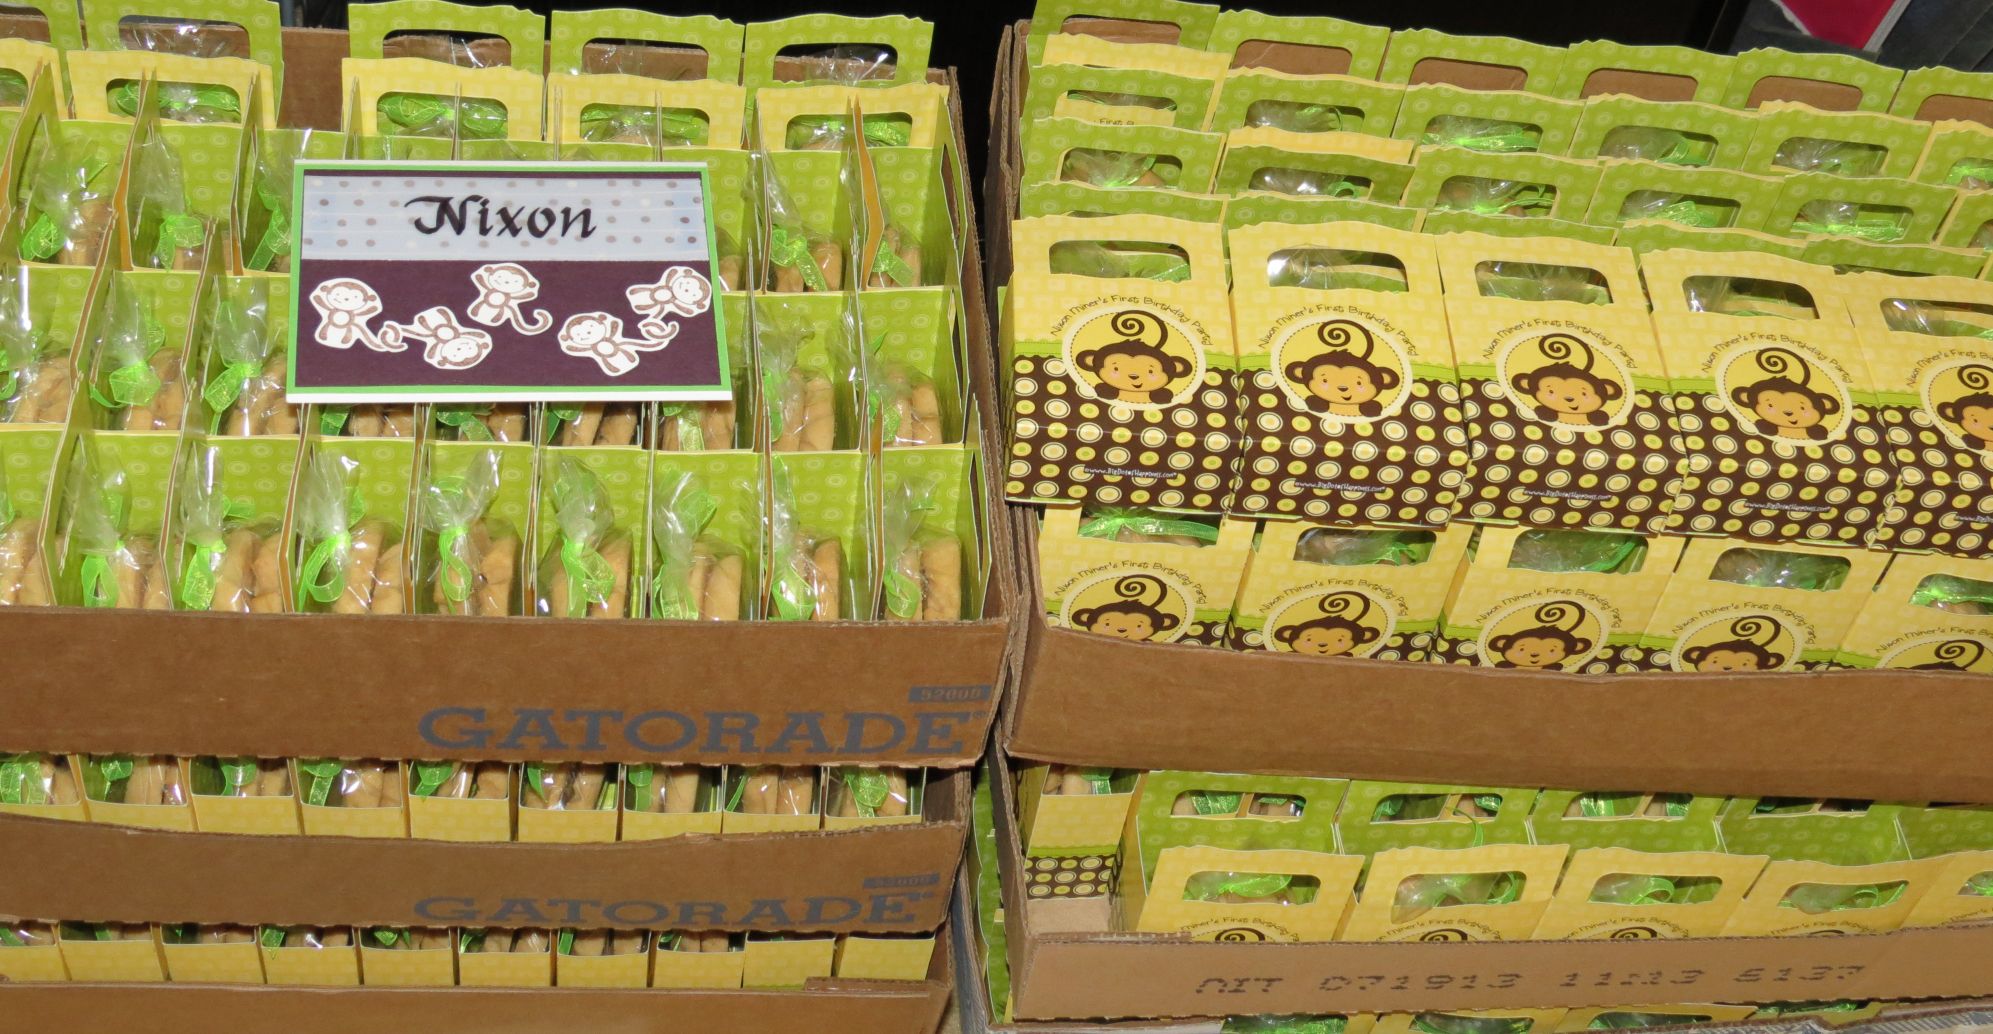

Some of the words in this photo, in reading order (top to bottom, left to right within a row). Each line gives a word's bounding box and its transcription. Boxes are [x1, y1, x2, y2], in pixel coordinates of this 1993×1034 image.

[404, 194, 597, 239] Nixon
[1050, 314, 1072, 336] Nixon
[1110, 294, 1140, 304] First
[1144, 296, 1190, 324] Birthday
[1191, 320, 1214, 346] Party
[1258, 326, 1279, 349] Nixon
[1316, 304, 1344, 313] First
[1348, 305, 1395, 332] Birthday
[1396, 330, 1419, 357] Party
[1483, 338, 1501, 359] Nixon
[1534, 318, 1562, 327] First
[1565, 320, 1613, 346] Birthday
[1614, 344, 1638, 369] Party
[1701, 351, 1718, 373] Nixon
[1750, 332, 1776, 341] First
[1780, 334, 1827, 360] Birthday
[1829, 358, 1854, 384] Party
[1906, 368, 1921, 388] Nixon
[1949, 349, 1976, 358] First
[1054, 577, 1079, 596] Nixon
[1122, 560, 1148, 569] First
[1152, 562, 1193, 586] Birthday
[1192, 584, 1208, 605] Party
[1259, 594, 1285, 614] Nixon
[1328, 578, 1354, 586] First
[1358, 579, 1397, 600] Birthday
[1476, 604, 1502, 624] Nixon
[1546, 587, 1572, 595] First
[1575, 588, 1611, 610] Birthday
[1672, 616, 1699, 634] Nixon
[1744, 602, 1768, 610] First
[1876, 637, 1904, 654] Nixon
[417, 707, 971, 755] GATORADE
[413, 892, 921, 927] GATORADE
